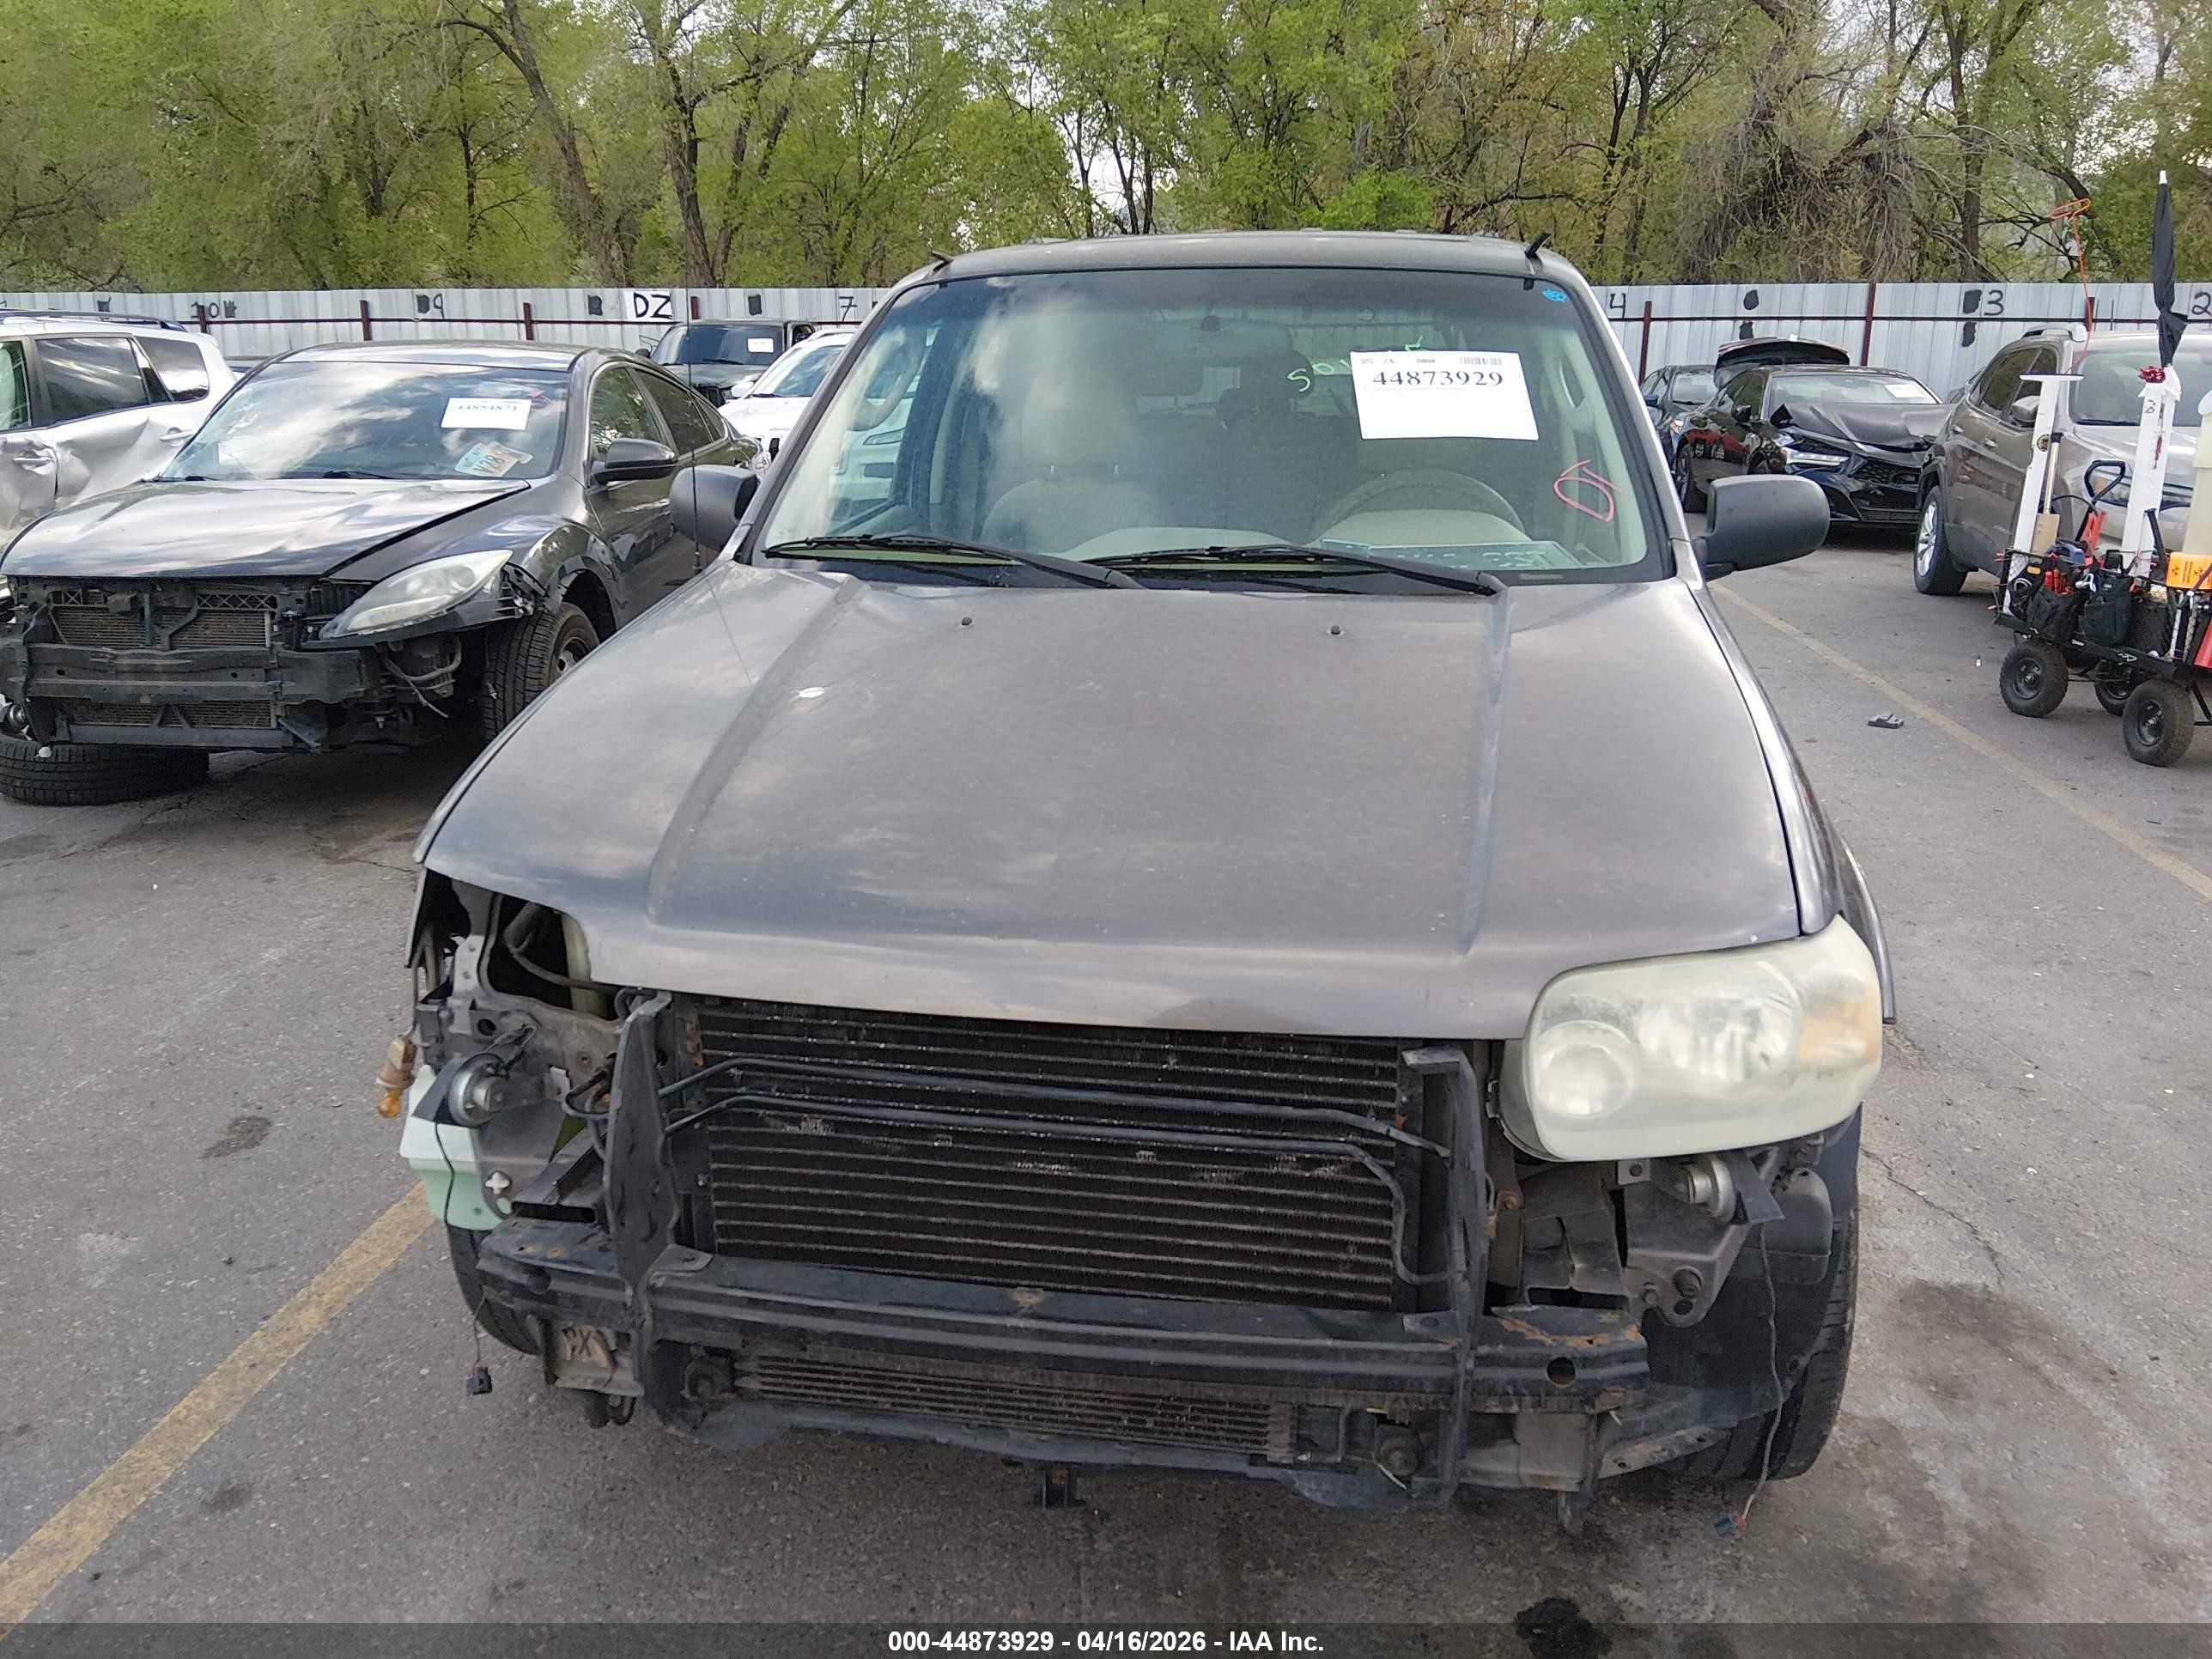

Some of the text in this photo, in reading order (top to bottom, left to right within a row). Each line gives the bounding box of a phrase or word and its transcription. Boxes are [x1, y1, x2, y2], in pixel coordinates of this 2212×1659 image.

[838, 295, 858, 321] 7
[1609, 293, 1626, 319] 4
[1984, 289, 2005, 316] 3
[2191, 291, 2212, 315] 2
[1373, 370, 1504, 386] 44873929
